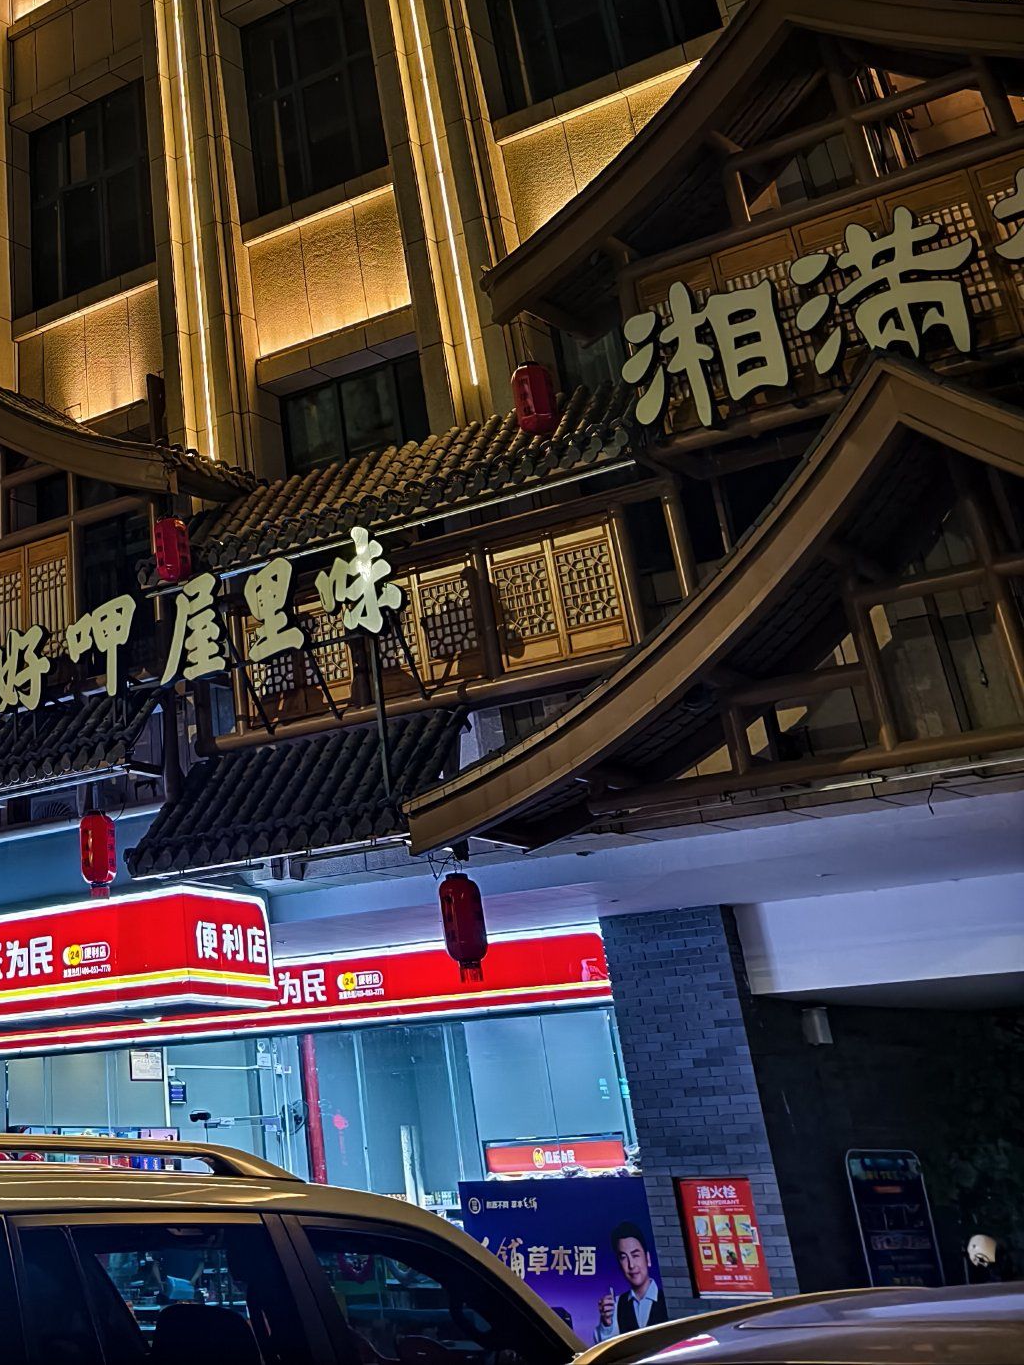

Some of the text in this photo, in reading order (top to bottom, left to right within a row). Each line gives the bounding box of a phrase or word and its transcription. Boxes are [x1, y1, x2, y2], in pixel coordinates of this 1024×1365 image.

[621, 168, 1024, 427] 湘满
[195, 920, 267, 964] 便利店
[278, 968, 328, 1005] 为民
[696, 1184, 738, 1200] 消火栓
[480, 1236, 597, 1281] 铺草本酒
